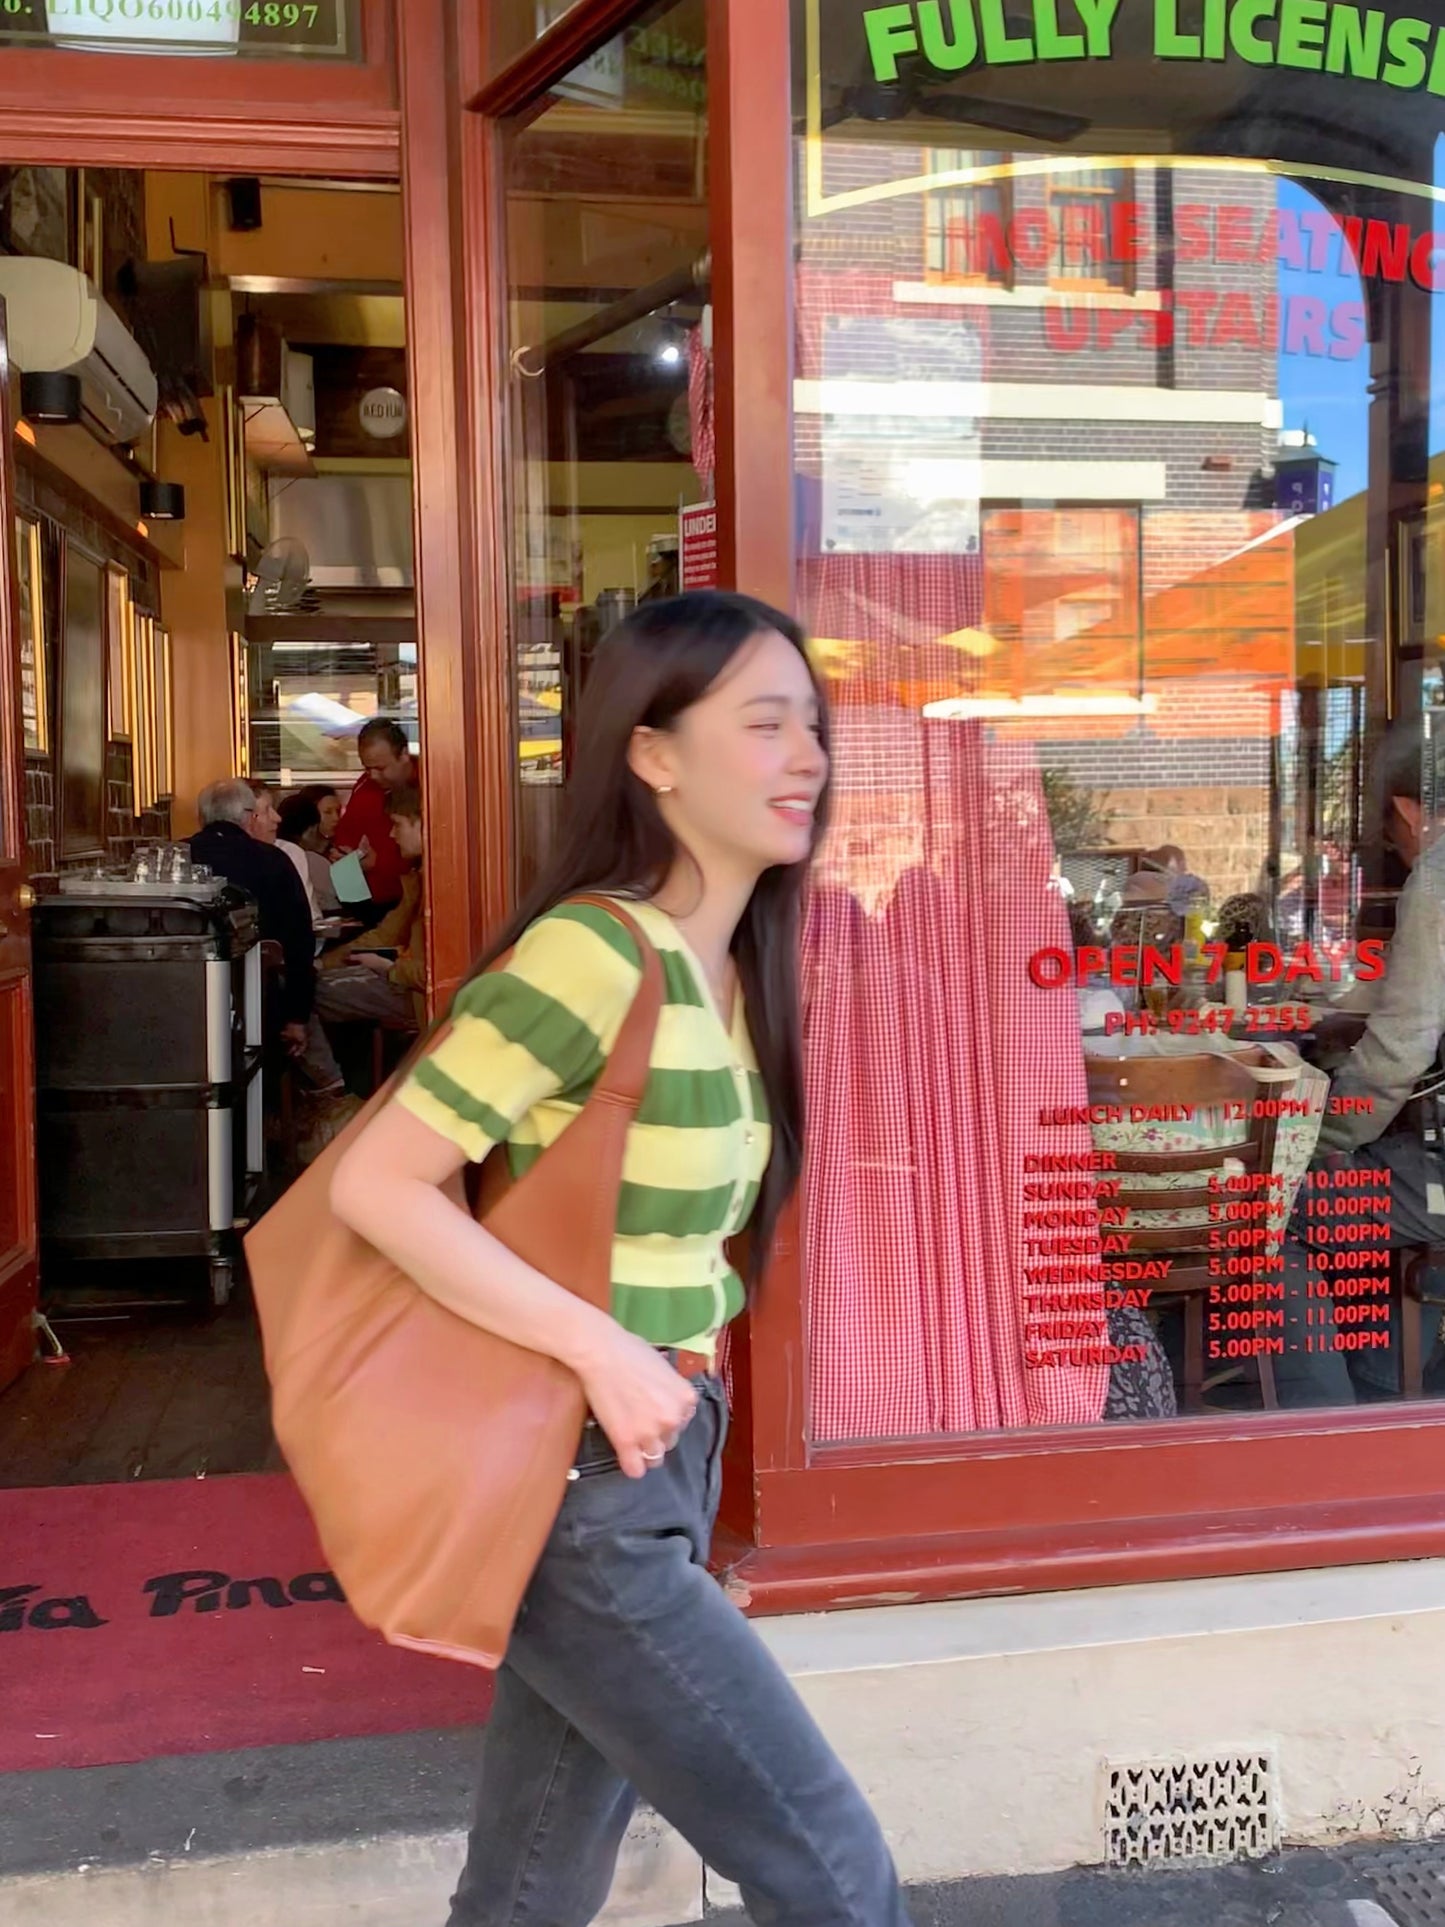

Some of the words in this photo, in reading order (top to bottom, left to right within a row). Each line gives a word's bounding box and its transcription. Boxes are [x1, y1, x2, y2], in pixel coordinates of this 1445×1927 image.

[862, 0, 1118, 84] FULLY
[1153, 0, 1445, 97] LICENS
[946, 202, 1146, 278] MORE
[1173, 204, 1445, 294] SEATING
[1042, 288, 1367, 360] UPSTAIRS
[684, 513, 717, 538] UNDE
[1028, 944, 1183, 989] OPEN
[1200, 943, 1229, 985] 7
[1245, 938, 1386, 984] DAYS
[1104, 1009, 1157, 1037] PH:
[1167, 1008, 1235, 1035] 9247
[1245, 1006, 1312, 1032] 2255
[1039, 1104, 1123, 1126] LUNCH
[1130, 1102, 1197, 1122] DAILY
[1223, 1098, 1311, 1121] 12.00PM
[1328, 1096, 1375, 1117] 3PM
[1024, 1151, 1118, 1173] DINNER
[1024, 1178, 1124, 1201] SUNDAY
[1208, 1173, 1285, 1194] 5.00PM
[1306, 1169, 1391, 1190] 10.00PM
[1024, 1206, 1130, 1229] MONDAY
[1208, 1201, 1285, 1222] 5.00PM
[1306, 1195, 1391, 1217] 10.00PM
[1023, 1234, 1133, 1257] TUESDAY
[1208, 1227, 1285, 1249] 5.00PM
[1306, 1223, 1391, 1245] 10.00PM
[1024, 1260, 1173, 1285] WEDNESDAY
[1208, 1255, 1285, 1276] 5.00PM
[1306, 1250, 1390, 1272] 10.00PM
[1023, 1288, 1153, 1314] THURSDAY
[1208, 1282, 1285, 1303] 5.00PM
[1306, 1277, 1390, 1299] 10.00PM
[1025, 1320, 1108, 1341] FRIDAY
[1208, 1309, 1285, 1331] 5.00PM
[1306, 1304, 1390, 1327] 11.00PM
[1025, 1343, 1150, 1369] SATURDAY
[1208, 1336, 1285, 1359] 5.00PM
[1306, 1331, 1390, 1353] 11.00PM
